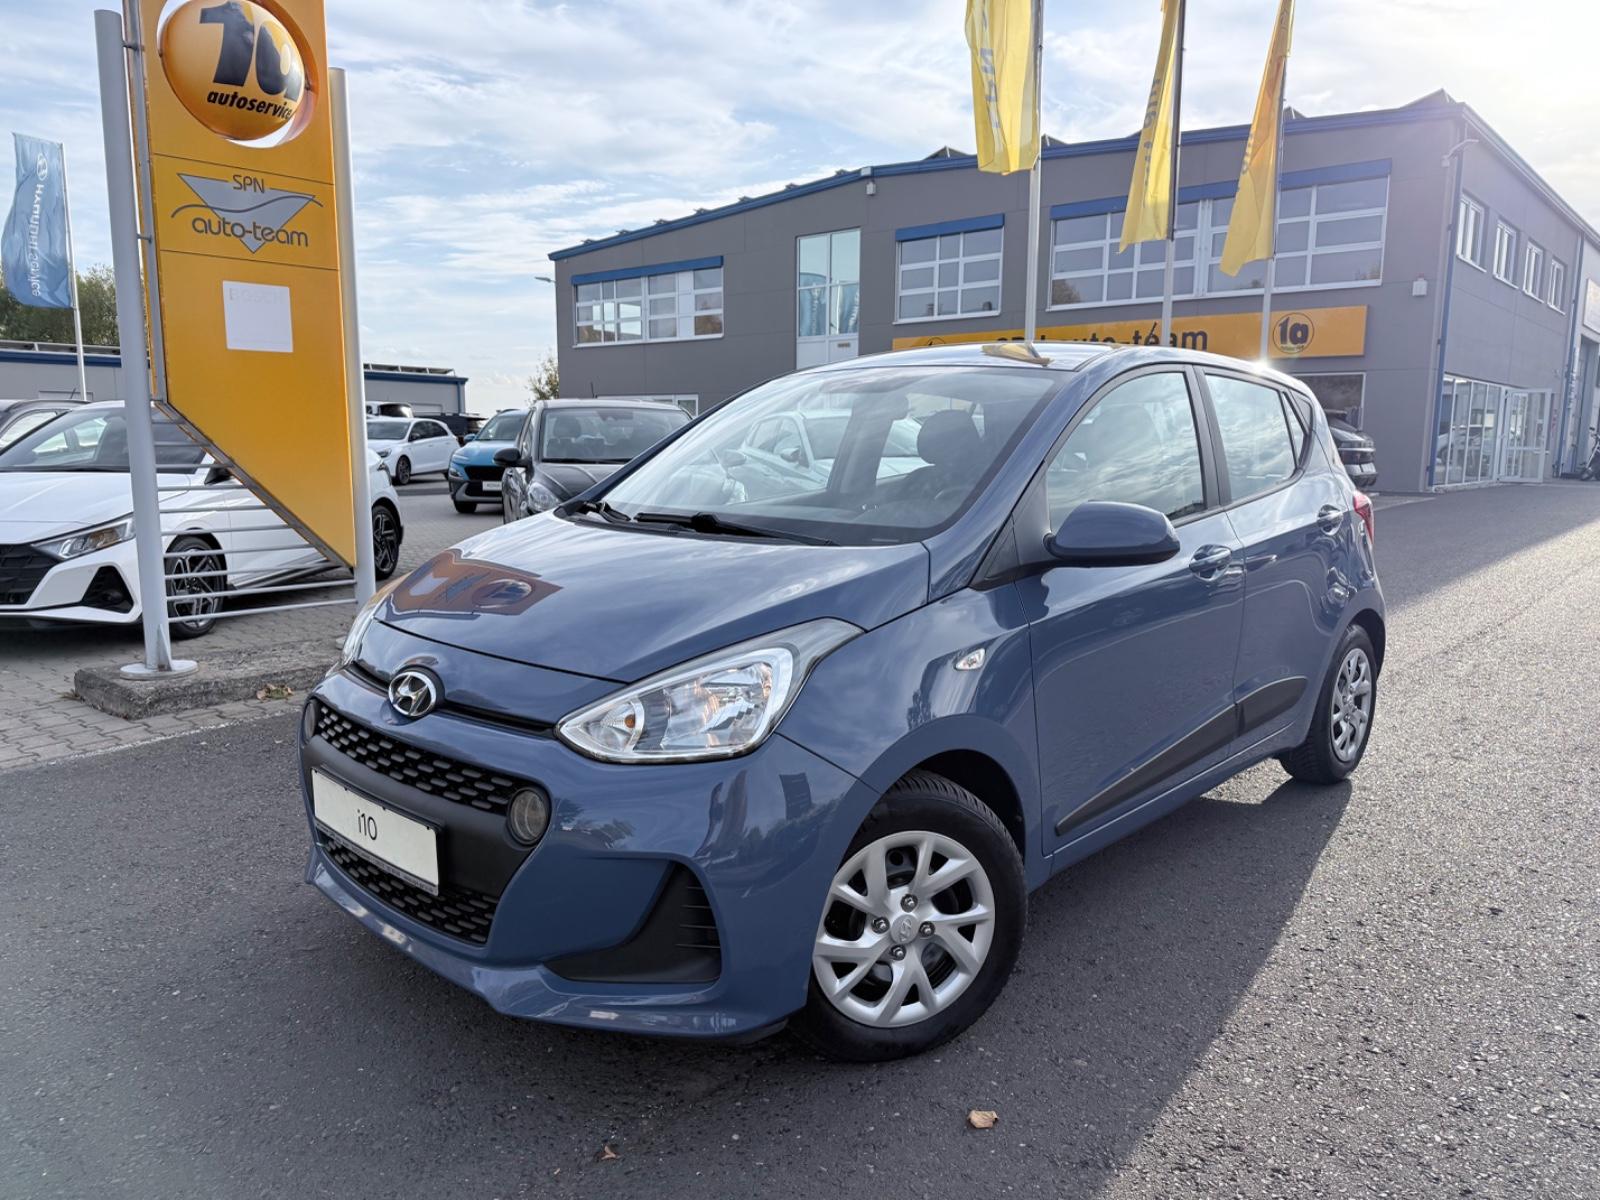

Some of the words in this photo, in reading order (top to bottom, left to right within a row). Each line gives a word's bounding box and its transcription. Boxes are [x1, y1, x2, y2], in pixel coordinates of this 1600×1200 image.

[207, 90, 293, 120] autoservice
[232, 174, 265, 194] SPN
[191, 217, 309, 247] auto-team
[357, 809, 378, 841] i10
